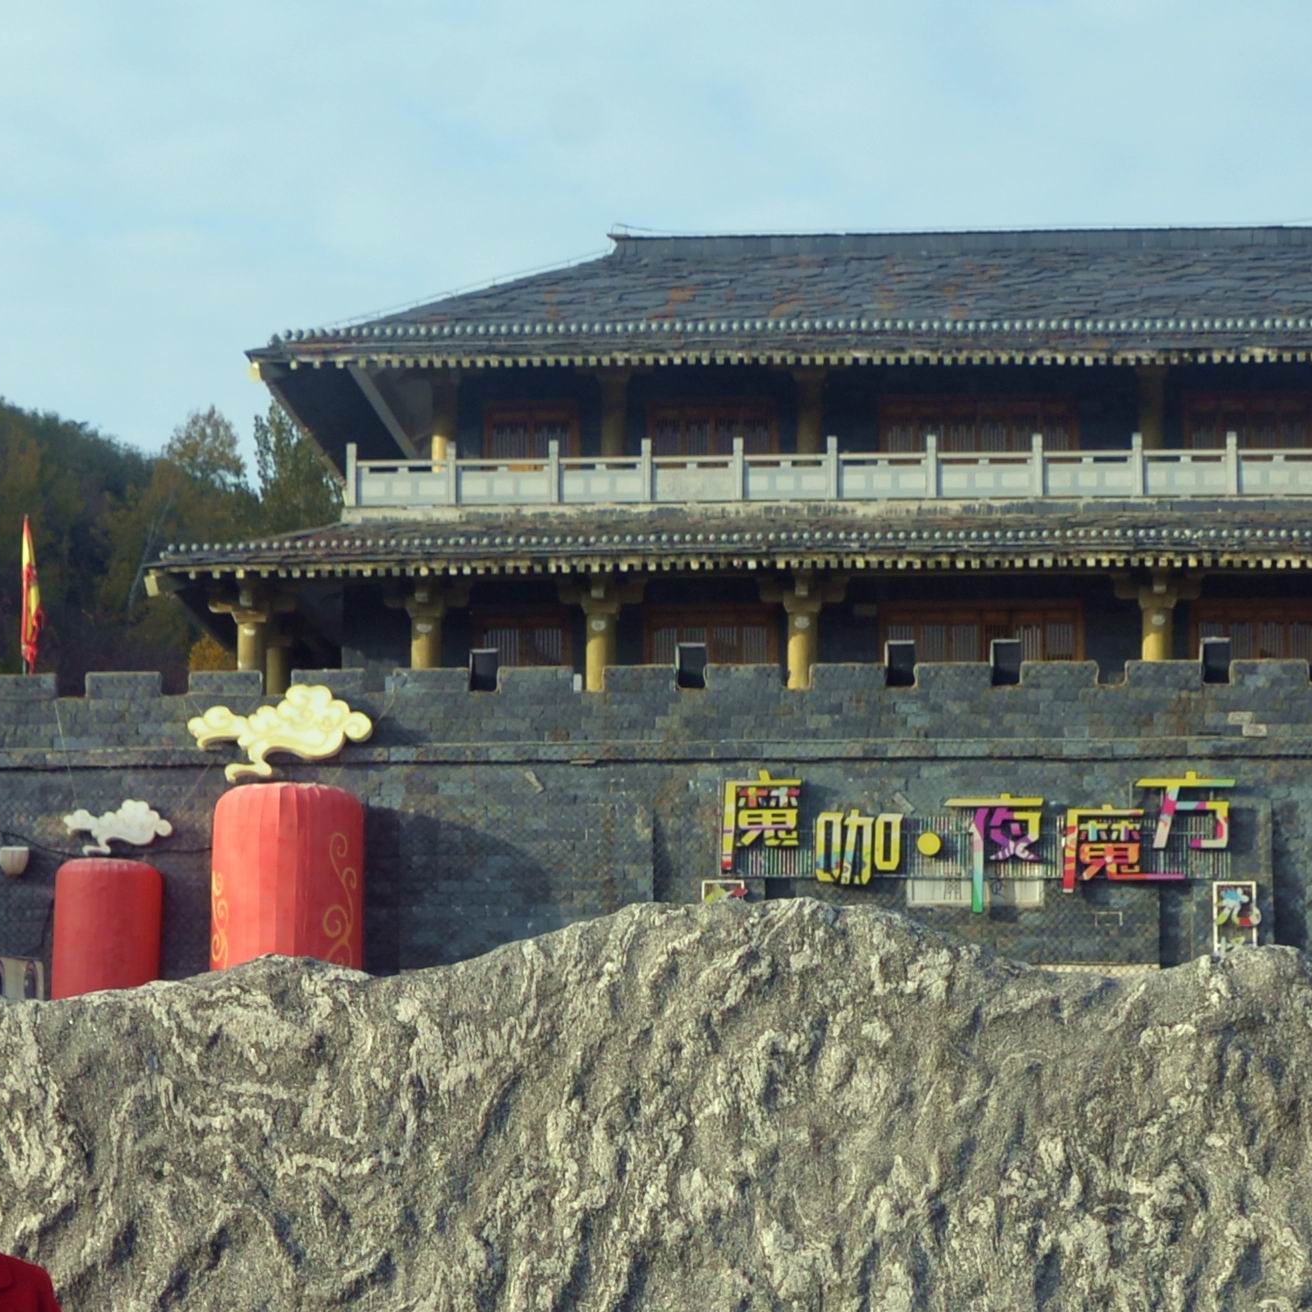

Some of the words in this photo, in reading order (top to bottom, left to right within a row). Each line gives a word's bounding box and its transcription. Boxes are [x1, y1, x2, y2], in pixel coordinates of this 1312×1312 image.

[719, 770, 1236, 912] 魔咖·夜魔方
